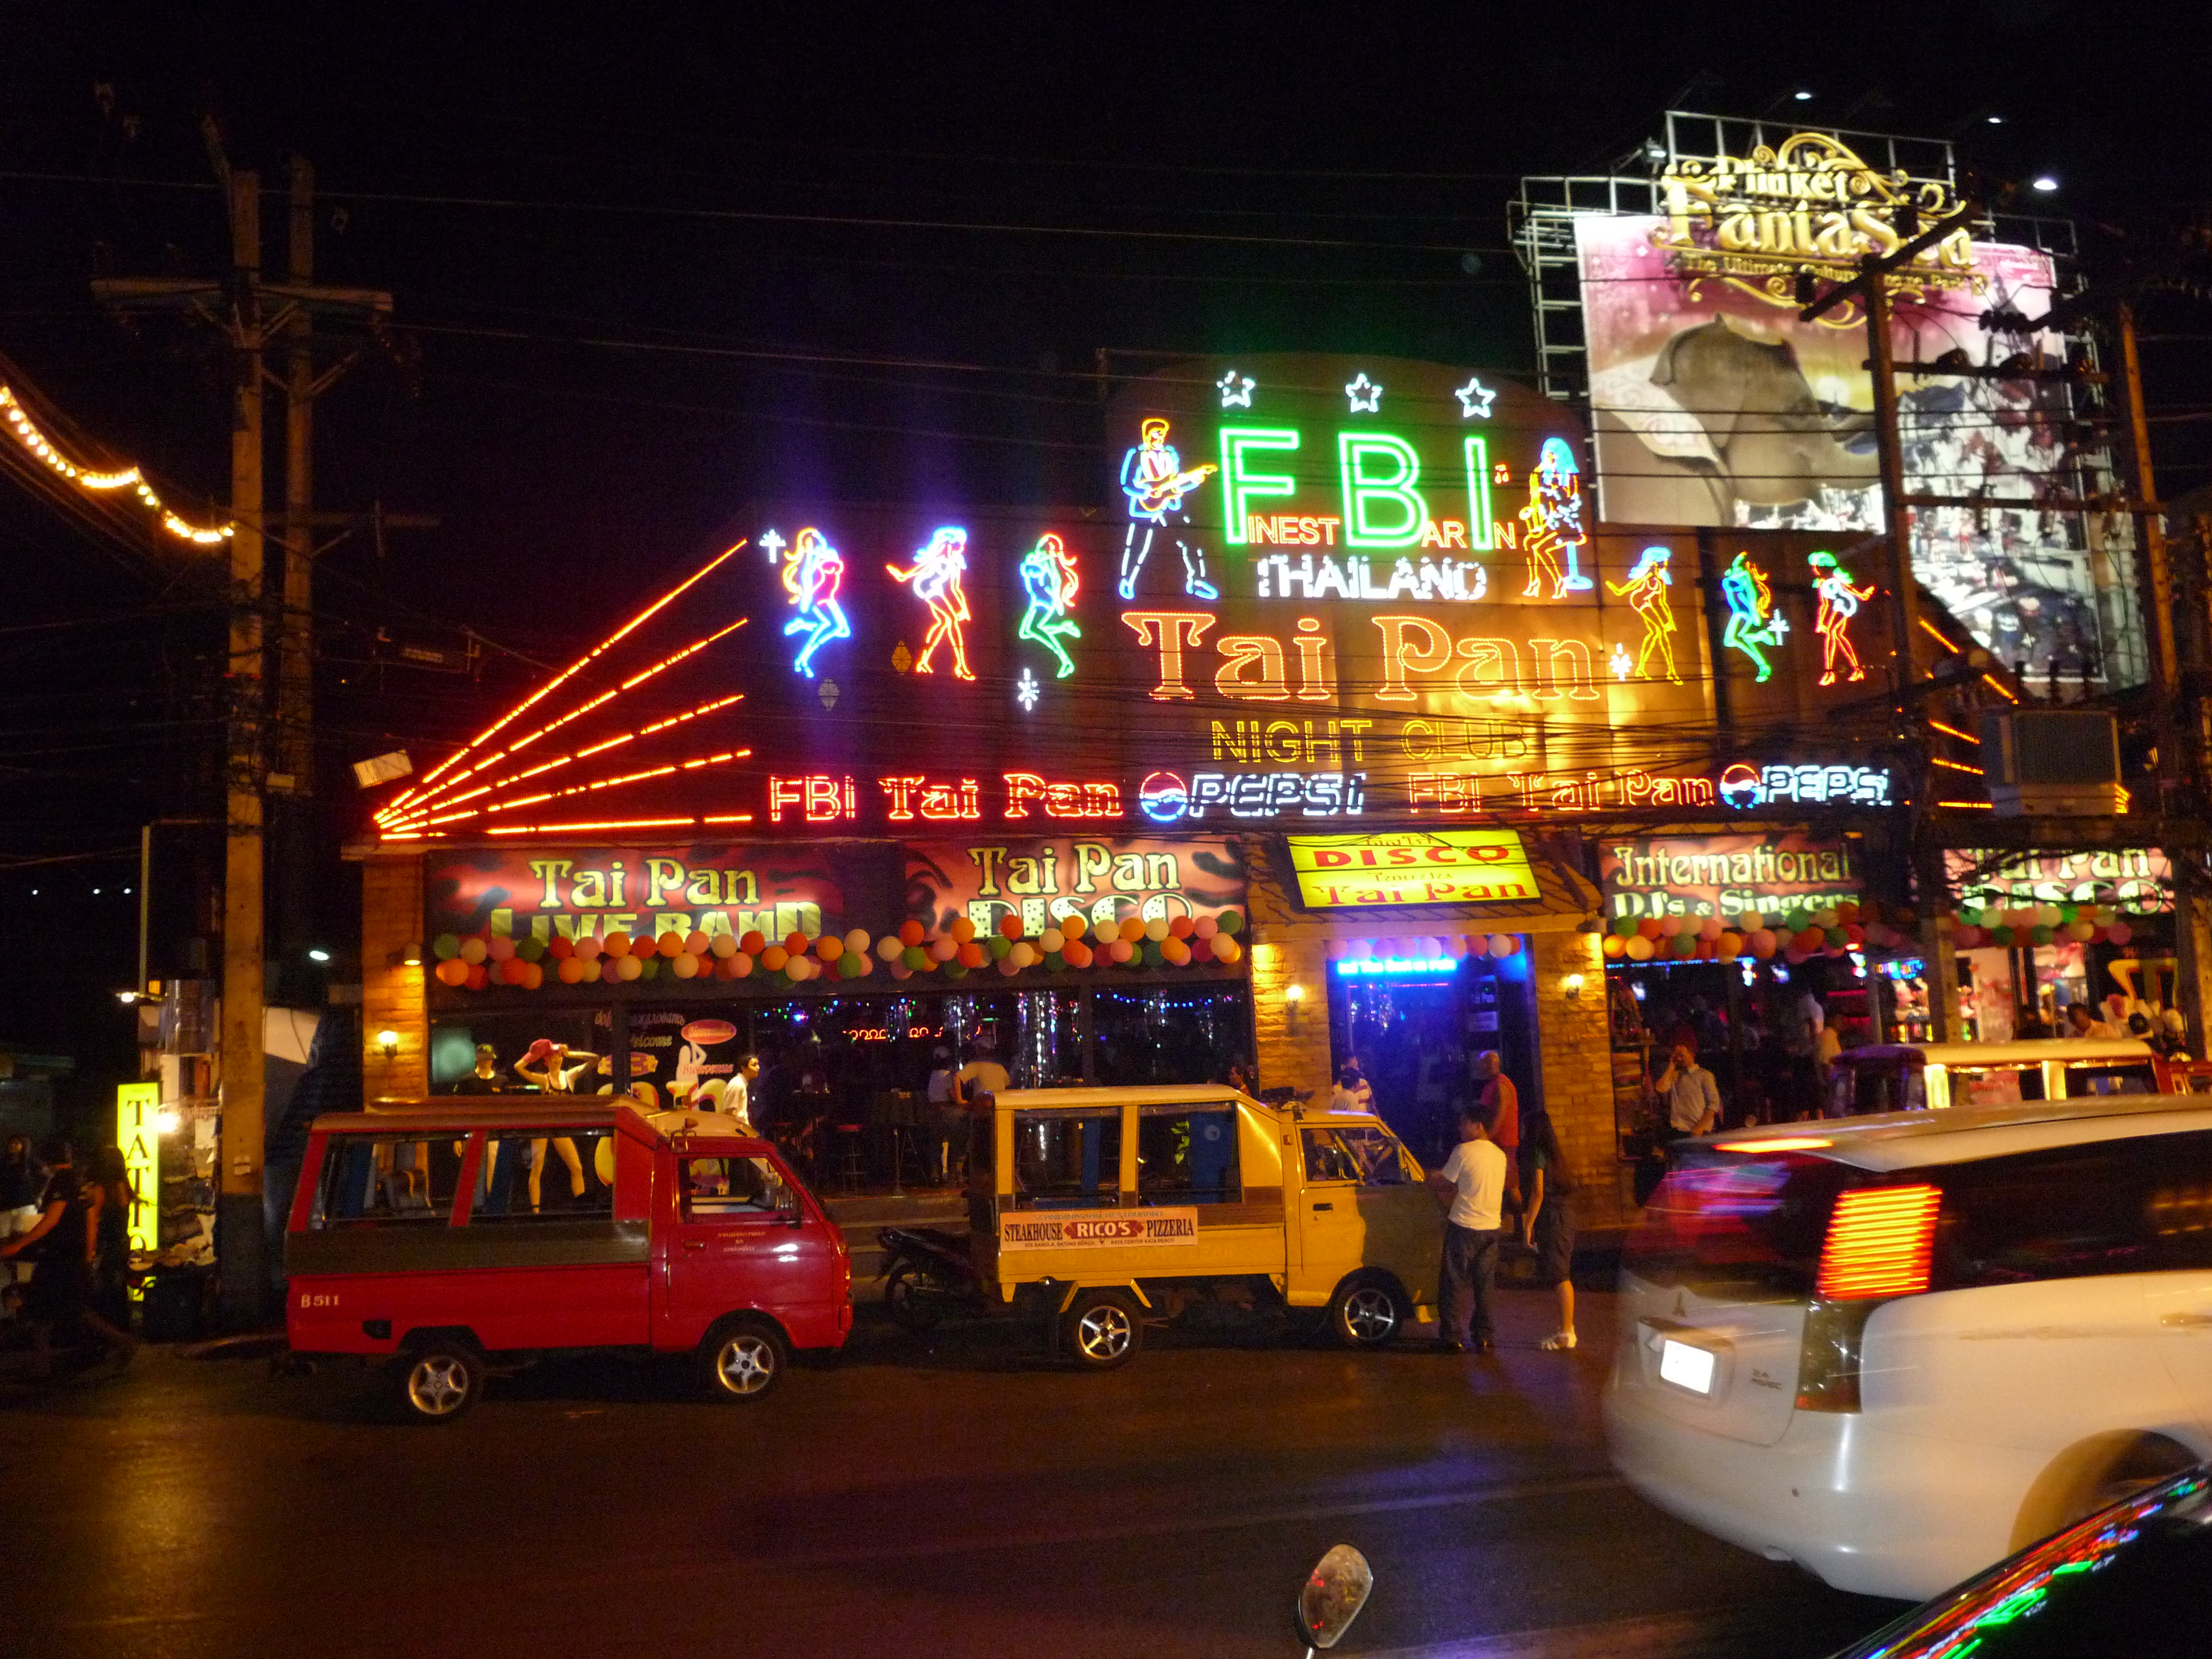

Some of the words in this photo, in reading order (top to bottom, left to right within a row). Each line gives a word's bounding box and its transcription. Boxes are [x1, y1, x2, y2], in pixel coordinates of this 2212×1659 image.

[1709, 156, 1849, 202] Phuket
[1724, 257, 1793, 275] Ultimate
[1257, 549, 1487, 600] THAILAND
[1121, 612, 1331, 701] Tai
[1371, 616, 1602, 701] Pan
[1212, 720, 1372, 763] NIGHT
[1401, 719, 1529, 760] CLUB
[770, 775, 856, 822] FBI
[878, 775, 981, 819] Tai
[1003, 773, 1124, 818] Pan
[1189, 773, 1367, 818] PEPSI
[1408, 772, 1481, 813] FBI
[1506, 772, 1601, 811] Tai
[1617, 769, 1715, 806] Pan
[1761, 765, 1892, 806] PEPSI
[967, 847, 1059, 896] Tai
[1073, 844, 1182, 893] Pan
[1313, 845, 1510, 867] DISCO
[1613, 843, 1851, 887] International
[528, 859, 627, 908] Tai
[645, 858, 760, 907] Pan
[1311, 885, 1406, 905] Tai
[1425, 882, 1529, 901] Pan
[1696, 901, 1715, 917] &
[1719, 889, 1860, 917] Singers
[490, 908, 638, 947] LIVE
[655, 902, 822, 947] BAND
[968, 893, 1193, 938] DISCO
[1004, 1222, 1063, 1242] STEAKHOUSE
[1076, 1221, 1132, 1238] RICO'S
[1146, 1219, 1194, 1238] PIZZERIA
